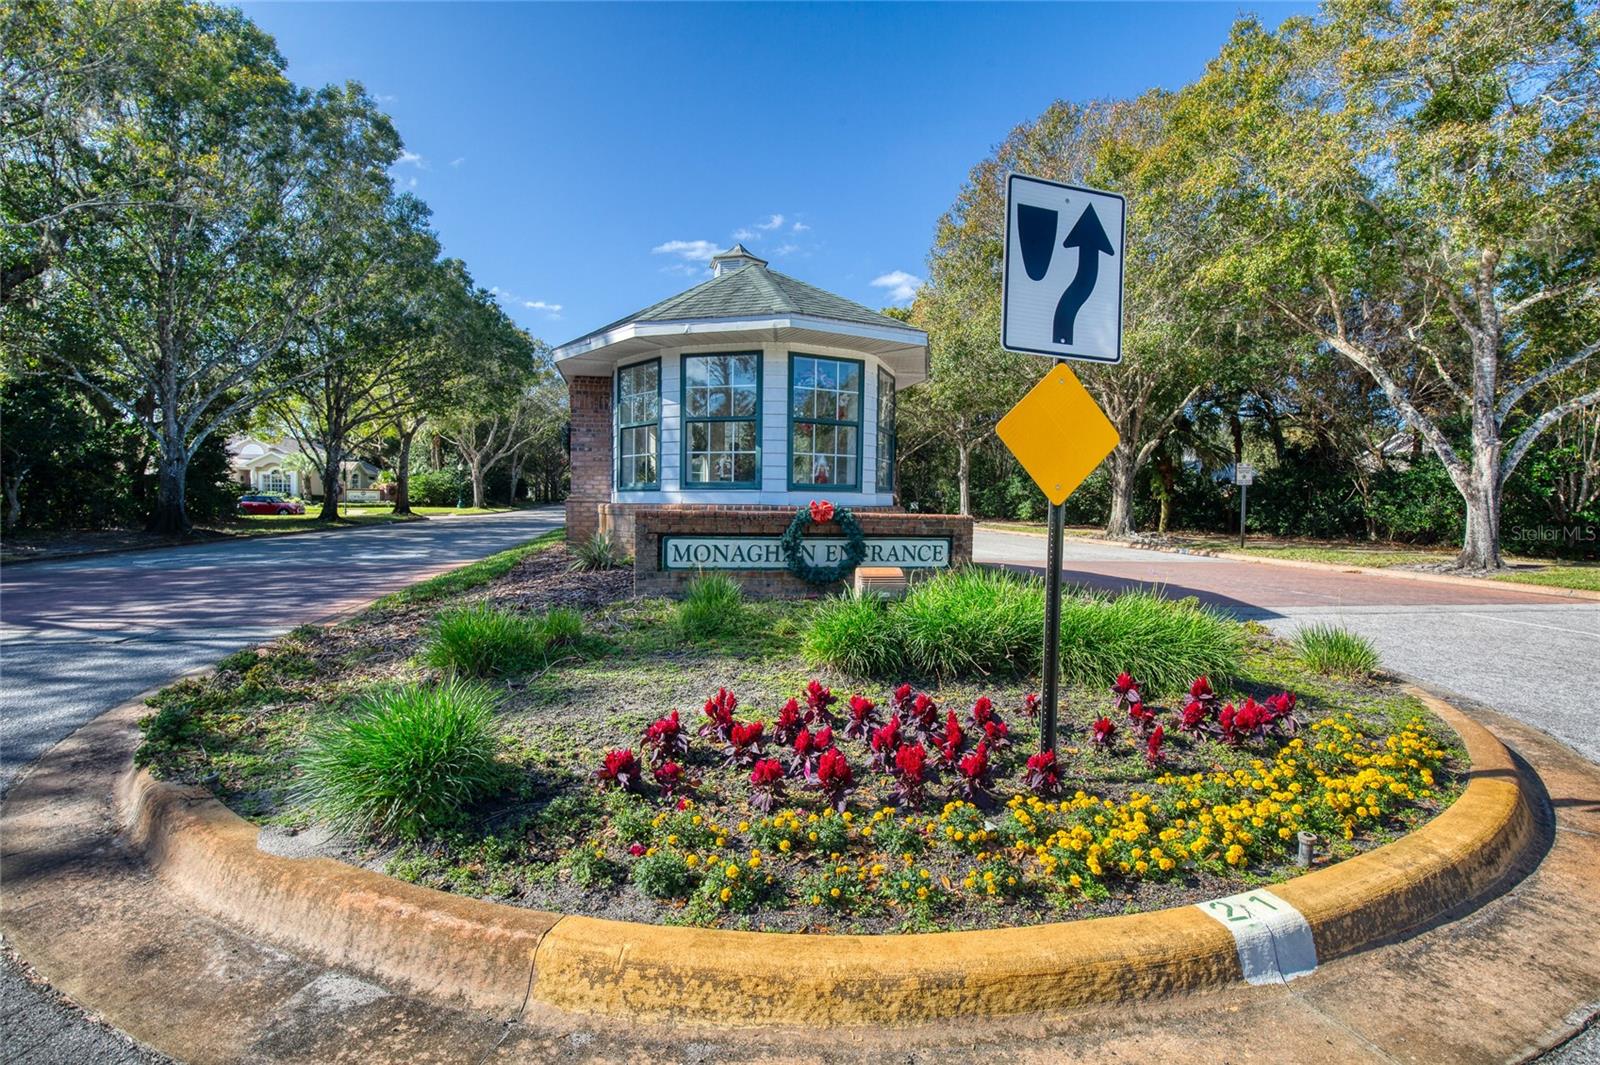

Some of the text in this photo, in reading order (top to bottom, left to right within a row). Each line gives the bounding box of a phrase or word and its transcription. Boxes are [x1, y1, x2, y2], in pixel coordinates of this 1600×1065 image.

[672, 544, 943, 562] MONAGHN ENRANCE
[1209, 896, 1278, 922] 21
